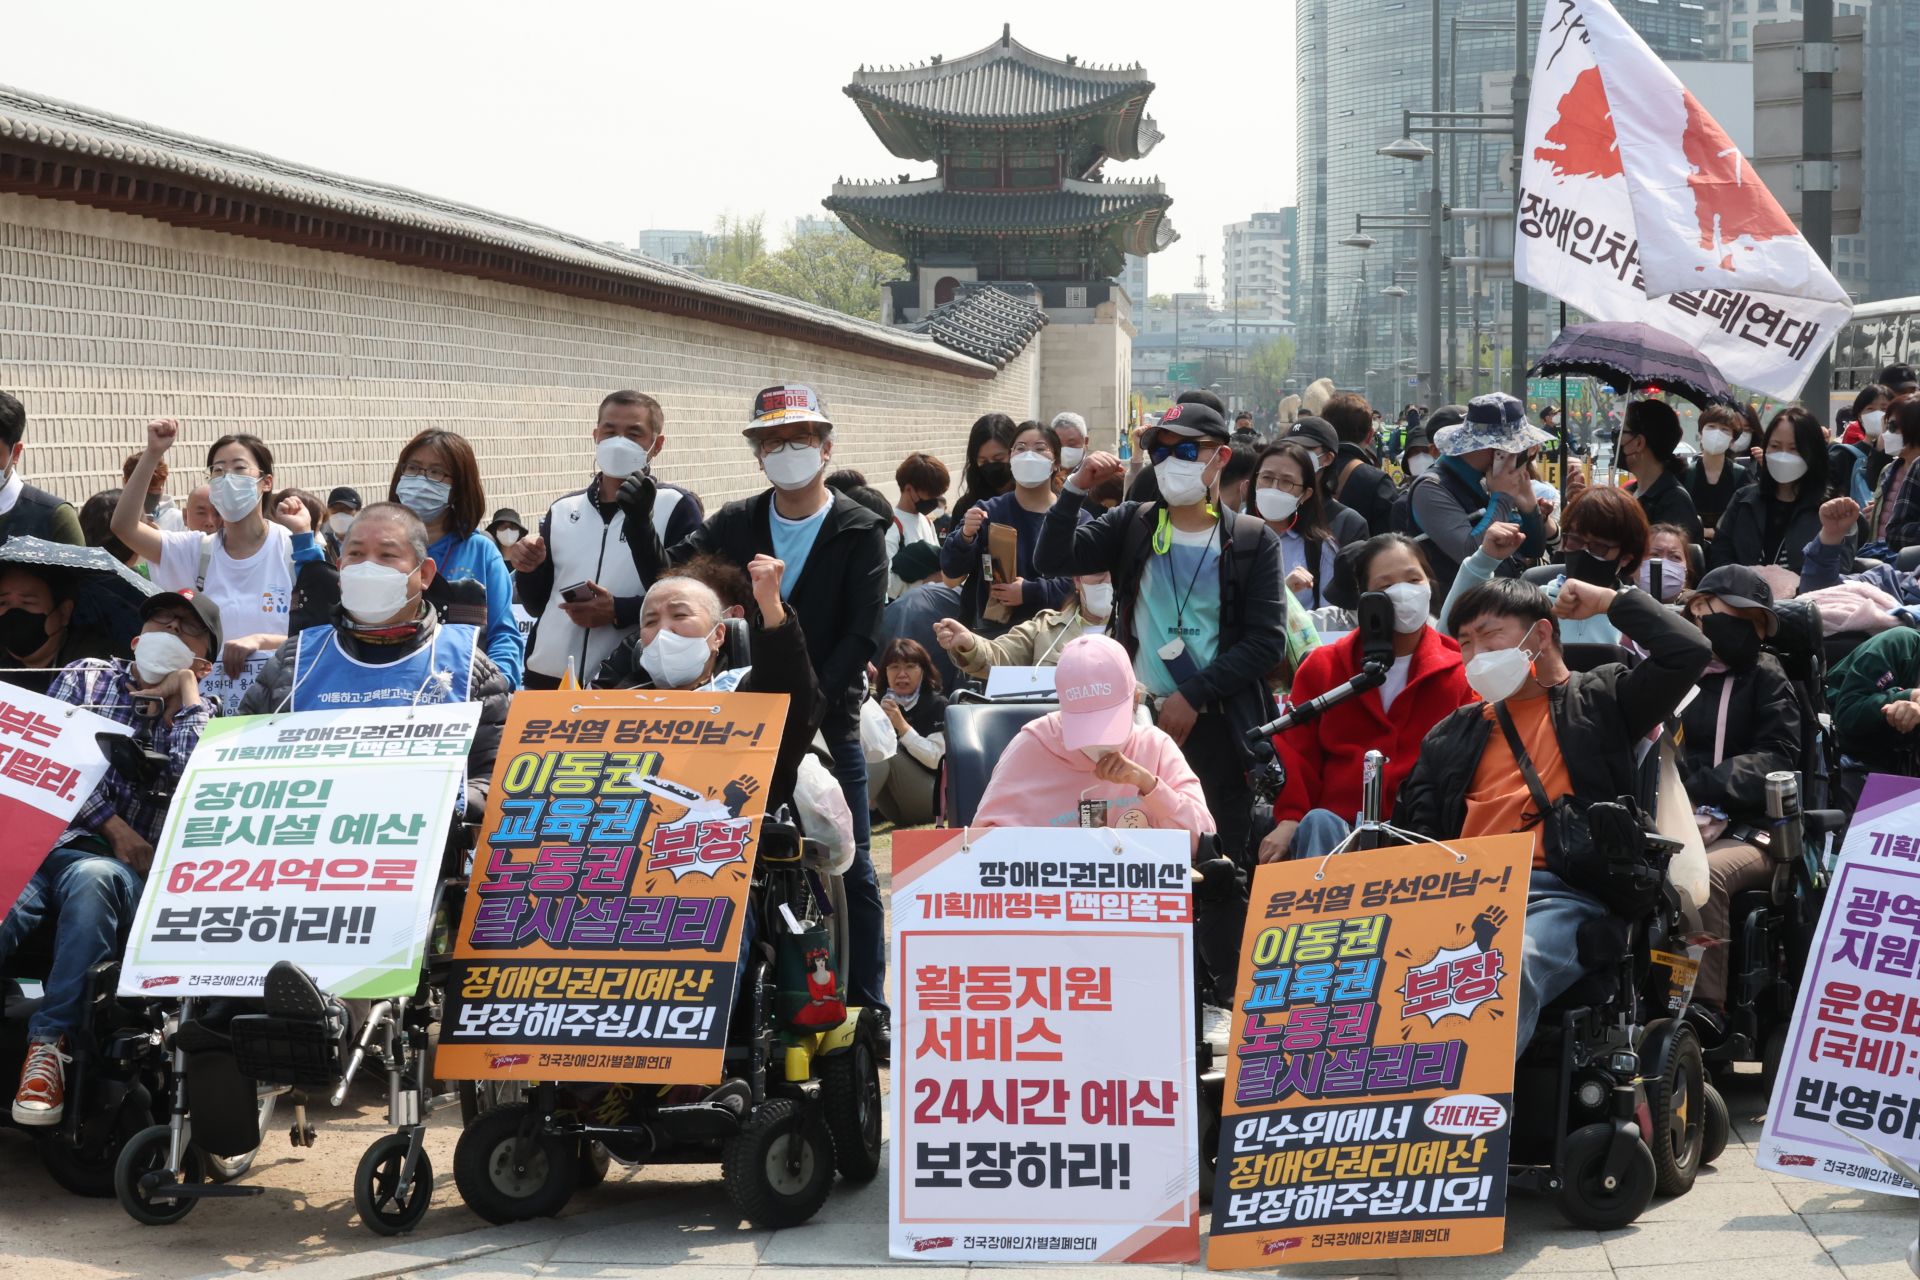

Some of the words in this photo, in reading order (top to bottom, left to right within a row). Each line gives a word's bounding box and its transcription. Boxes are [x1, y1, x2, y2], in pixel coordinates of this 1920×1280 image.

[0, 701, 62, 748] 부는
[278, 723, 472, 743] 장애인권리예산
[519, 719, 608, 745] 윤석열
[615, 719, 766, 747] 당선인님~!
[215, 743, 349, 762] 기획재정부
[351, 739, 471, 758] 책임촉구
[194, 779, 334, 812] 장애인
[502, 752, 658, 796] 이동권
[181, 814, 318, 849] 탈시설
[330, 813, 427, 846] 예산
[489, 798, 646, 844] 교육권
[648, 820, 750, 871] 보장
[1869, 831, 1920, 863] 기획
[166, 859, 418, 894] 6224억으로
[478, 846, 636, 894] 노동권
[979, 861, 1186, 889] 장애인권리예산
[1264, 884, 1356, 919] 윤석열
[1362, 866, 1512, 907] 당선인님~!
[151, 906, 377, 945] 보장하라!!
[469, 895, 731, 945] 탈시설권리
[915, 892, 1062, 920] 기획재정부
[1067, 892, 1188, 921] 책임촉구
[1252, 915, 1387, 967] 이동권
[1832, 928, 1920, 980] 지원
[462, 965, 714, 1002] 장애인권리예산
[915, 965, 1112, 1012] 활동지원
[1243, 959, 1381, 1010] 교육권
[1403, 949, 1504, 1018] 보장
[453, 1002, 717, 1040] 보장해주십시오!
[915, 1017, 1063, 1062] 서비스
[1237, 1003, 1375, 1057] 노동권
[538, 1053, 672, 1070] 전국장애인차별철폐연대
[1234, 1040, 1459, 1103] 탈시설권리
[1809, 1027, 1920, 1080] (국비):
[914, 1078, 1070, 1125] 24시간
[1081, 1079, 1179, 1127] 예산
[1428, 1098, 1502, 1128] 제대로
[1234, 1105, 1413, 1153] 인수위에서
[915, 1141, 1131, 1190] 보장하라!
[1229, 1139, 1488, 1190] 장애인권리예산
[1823, 1159, 1920, 1191] 전국장애인차별
[1223, 1175, 1493, 1229] 보장해주십시오!
[963, 1236, 1097, 1250] 전국장애인차별철폐연대
[1311, 1228, 1450, 1248] 전국장애인차별철폐연대
